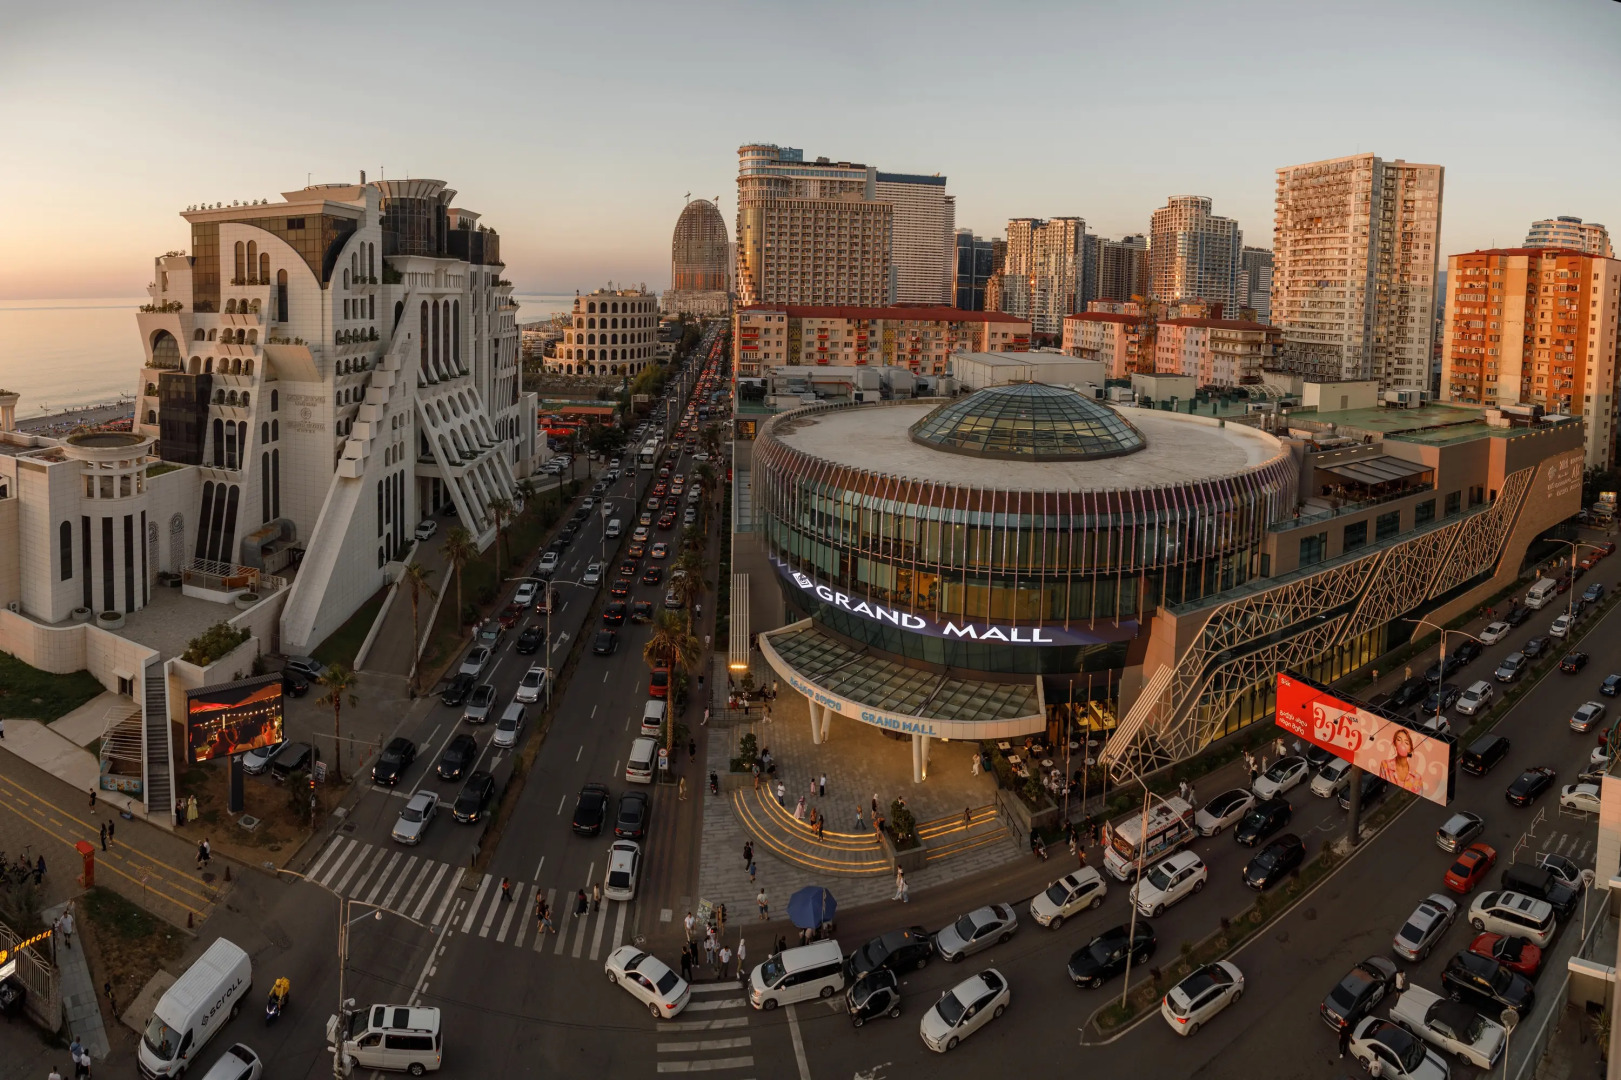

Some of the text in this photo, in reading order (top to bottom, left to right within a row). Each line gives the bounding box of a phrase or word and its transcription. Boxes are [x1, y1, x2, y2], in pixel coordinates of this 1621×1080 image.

[816, 586, 1053, 643] GRAND MALL
[861, 711, 937, 735] GRAND MALL
[1313, 706, 1362, 752] მერე
[14, 929, 52, 953] KARAOKE
